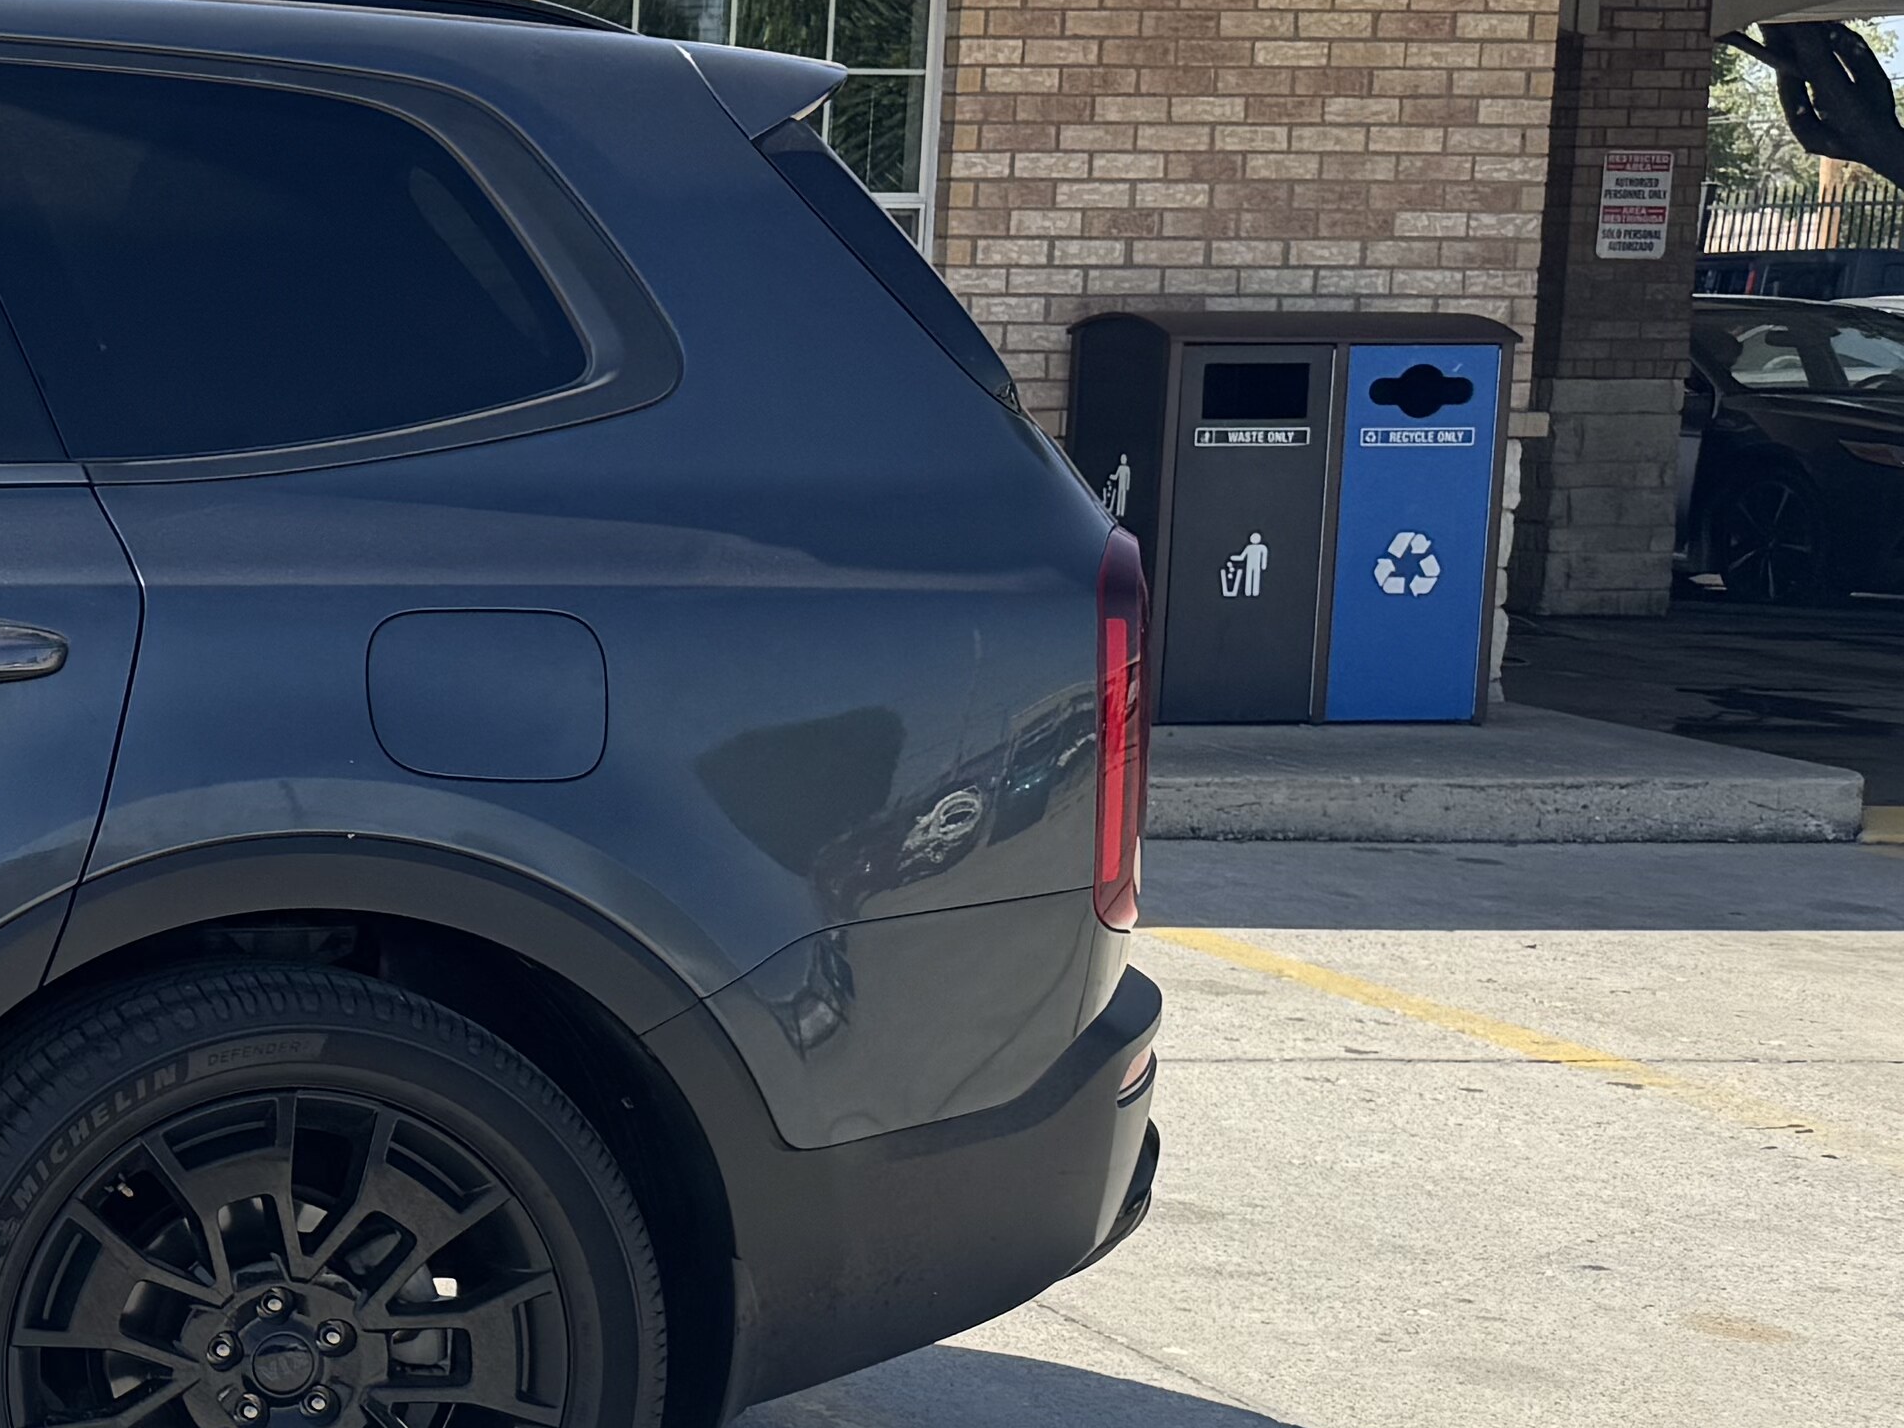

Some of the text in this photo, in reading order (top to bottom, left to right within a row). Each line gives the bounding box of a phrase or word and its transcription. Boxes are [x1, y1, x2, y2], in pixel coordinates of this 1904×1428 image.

[1608, 154, 1670, 164] RESTRICTED
[1624, 163, 1652, 171] AREA
[1615, 177, 1659, 188] AUTHORIZED
[1604, 189, 1667, 199] PERSONNEL ONLY
[1624, 230, 1661, 240] PERSONAL
[1608, 241, 1654, 252] AUTORIZADO
[1227, 431, 1295, 443] WASTE ONLY
[1388, 431, 1465, 443] RECYCLE ONLY
[10, 1063, 178, 1212] MICHELIN
